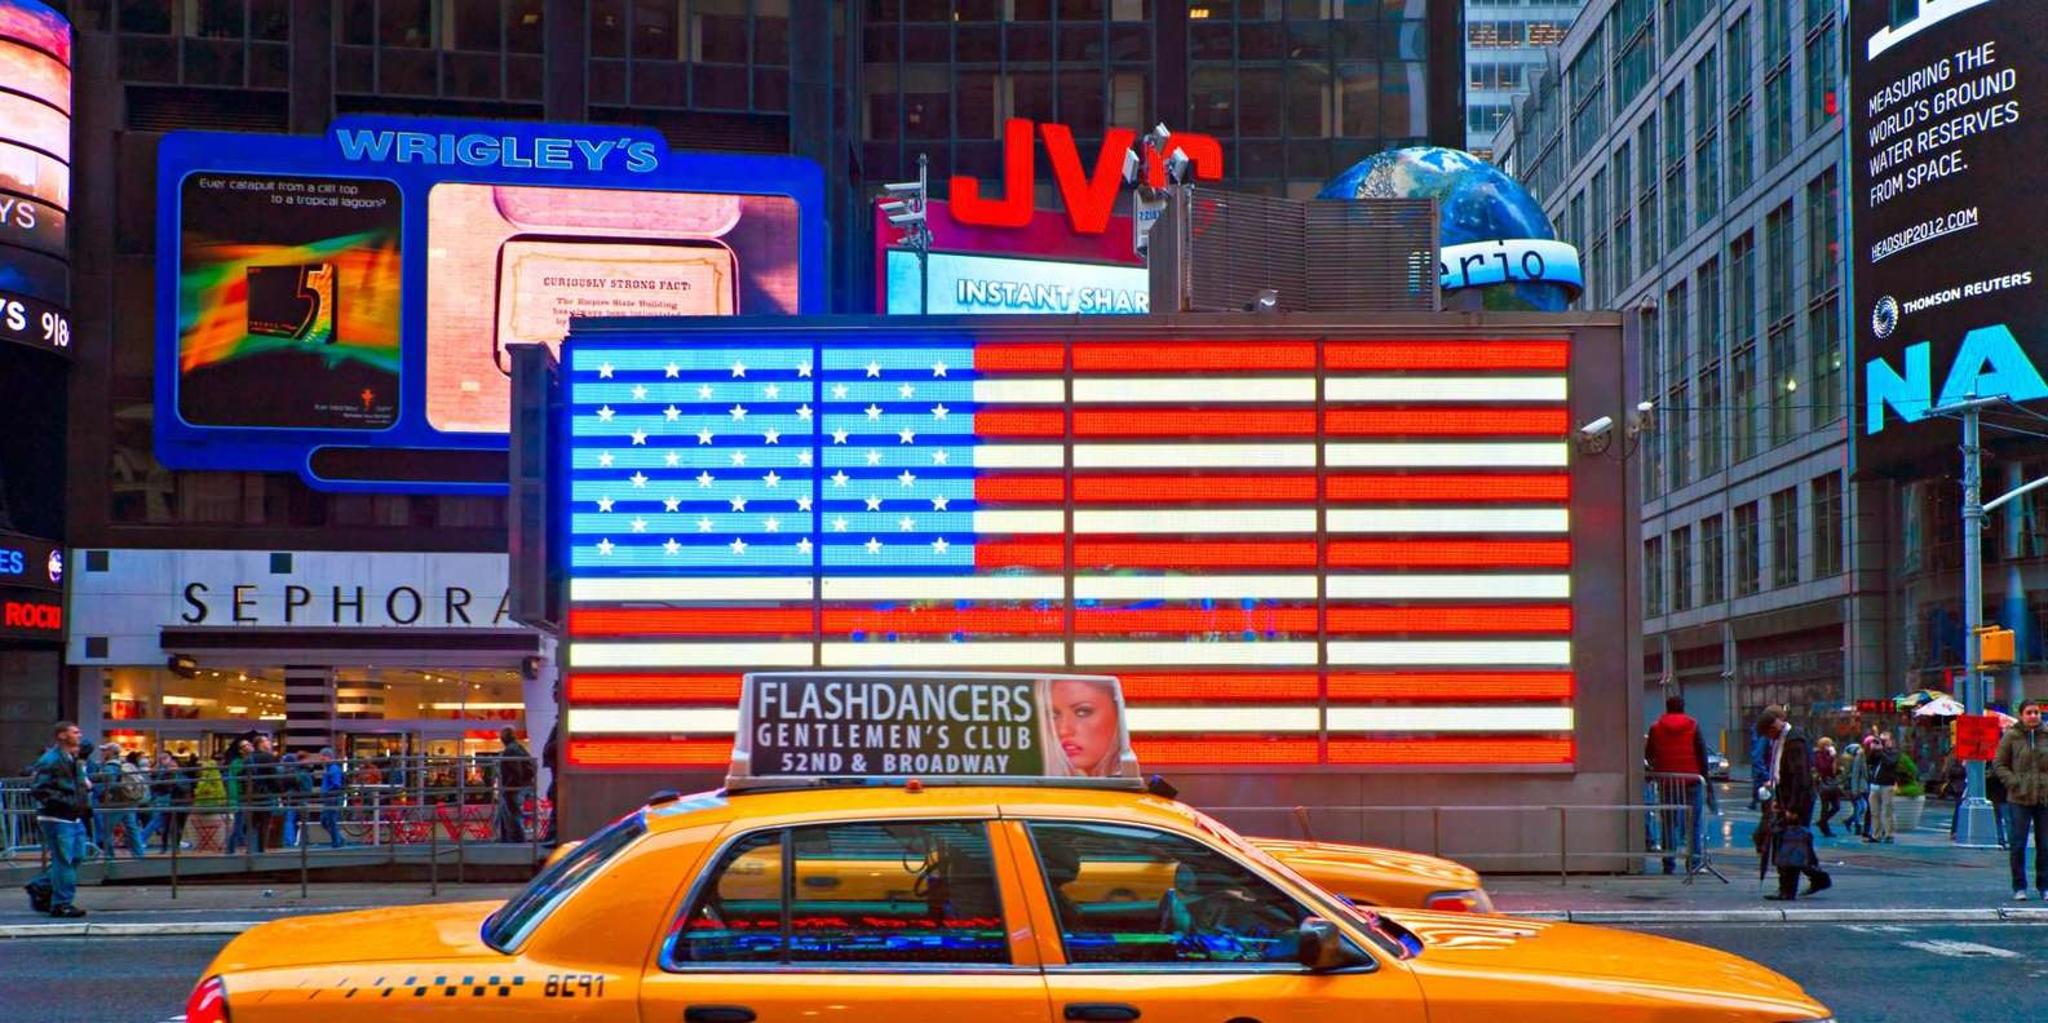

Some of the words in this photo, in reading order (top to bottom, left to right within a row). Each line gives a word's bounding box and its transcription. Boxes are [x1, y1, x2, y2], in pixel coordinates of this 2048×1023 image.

[1868, 58, 1950, 119] MEASURING
[1955, 40, 1996, 74] THE
[1869, 99, 1930, 148] WORLD'S
[1934, 68, 2017, 115] GROUND
[336, 129, 659, 173] WRIGLEY'S
[1869, 139, 1914, 178] WATER
[1917, 101, 2020, 154] RESERVES
[278, 182, 305, 193] from
[308, 185, 314, 193] a
[339, 184, 359, 195] top
[1870, 173, 1903, 208] FROM
[1906, 150, 1969, 190] SPACE.
[286, 196, 293, 205] a
[296, 195, 338, 208] tropical
[1871, 206, 1979, 261] HEADSUP2012.COM
[543, 276, 607, 289] CURIOUSLY
[610, 279, 656, 290] STRONG
[957, 278, 1073, 311] INSTANT
[1902, 287, 1961, 315] THOMSON
[1965, 271, 2033, 298] REUTERS
[758, 681, 1033, 723] FLASHDANCERS
[758, 722, 951, 749] GENTLEMEN'S
[965, 727, 1032, 750] CLUB
[780, 752, 843, 771] 52ND
[852, 754, 867, 773] &
[883, 753, 1009, 774] BROADWAY
